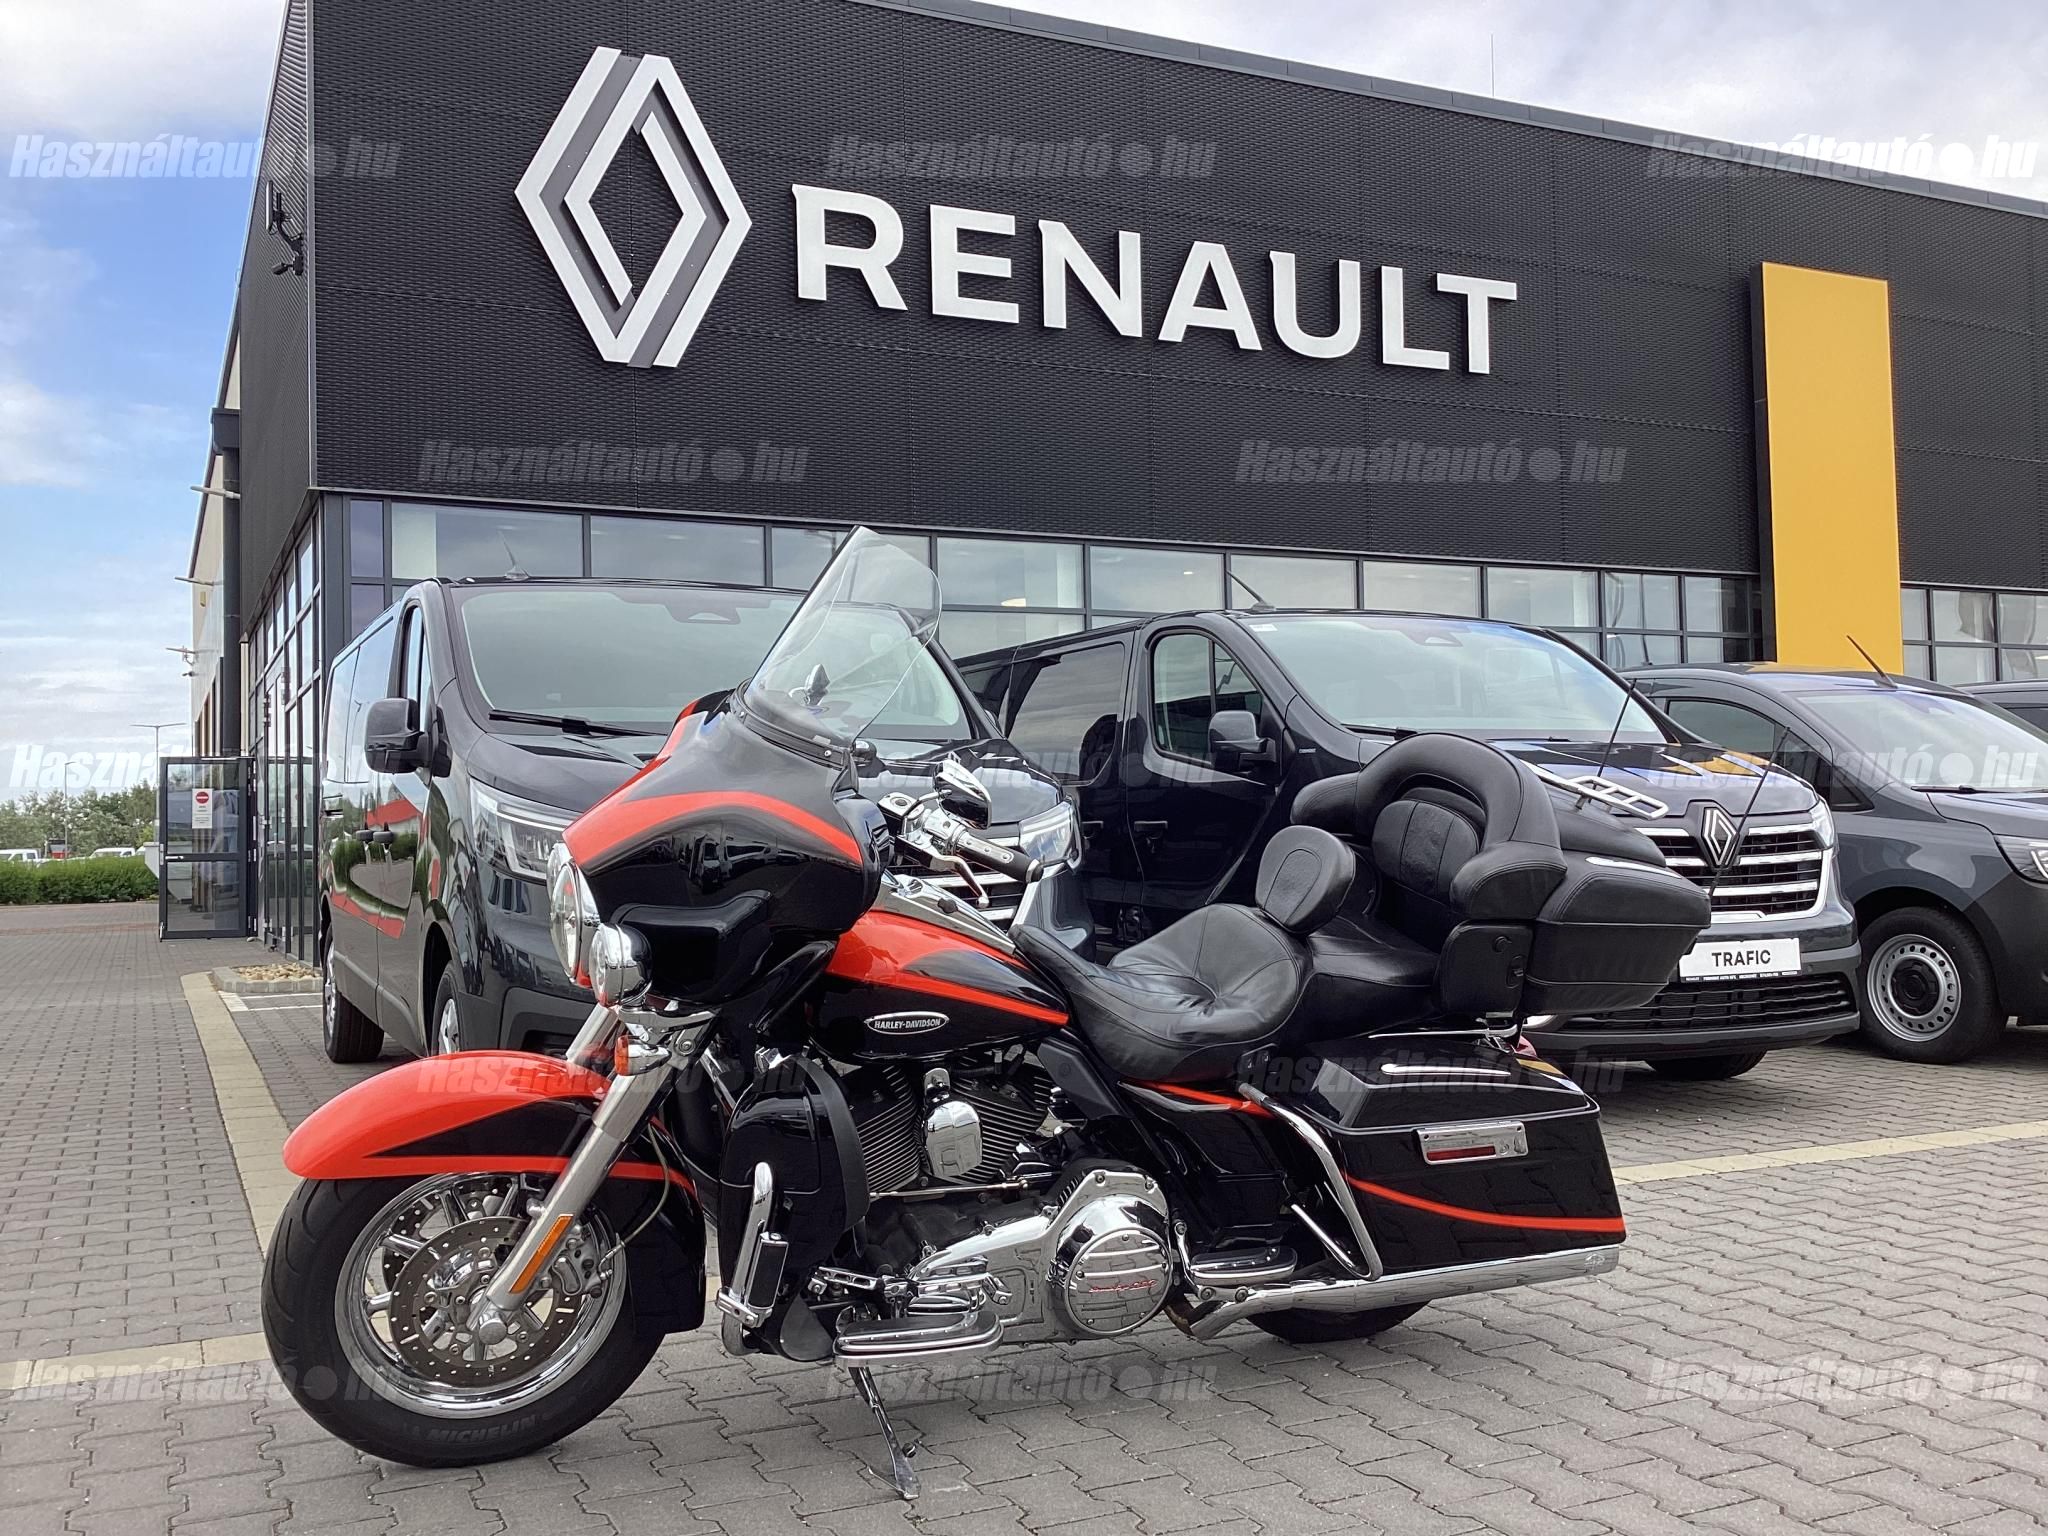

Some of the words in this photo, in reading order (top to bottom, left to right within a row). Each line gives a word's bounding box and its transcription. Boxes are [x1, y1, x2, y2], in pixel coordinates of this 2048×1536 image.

[791, 184, 1517, 374] RENAULT
[1712, 949, 1771, 967] TRAFIC
[874, 1018, 941, 1029] HARLEY-DAVIDSON
[425, 1413, 537, 1443] MICHELIN
